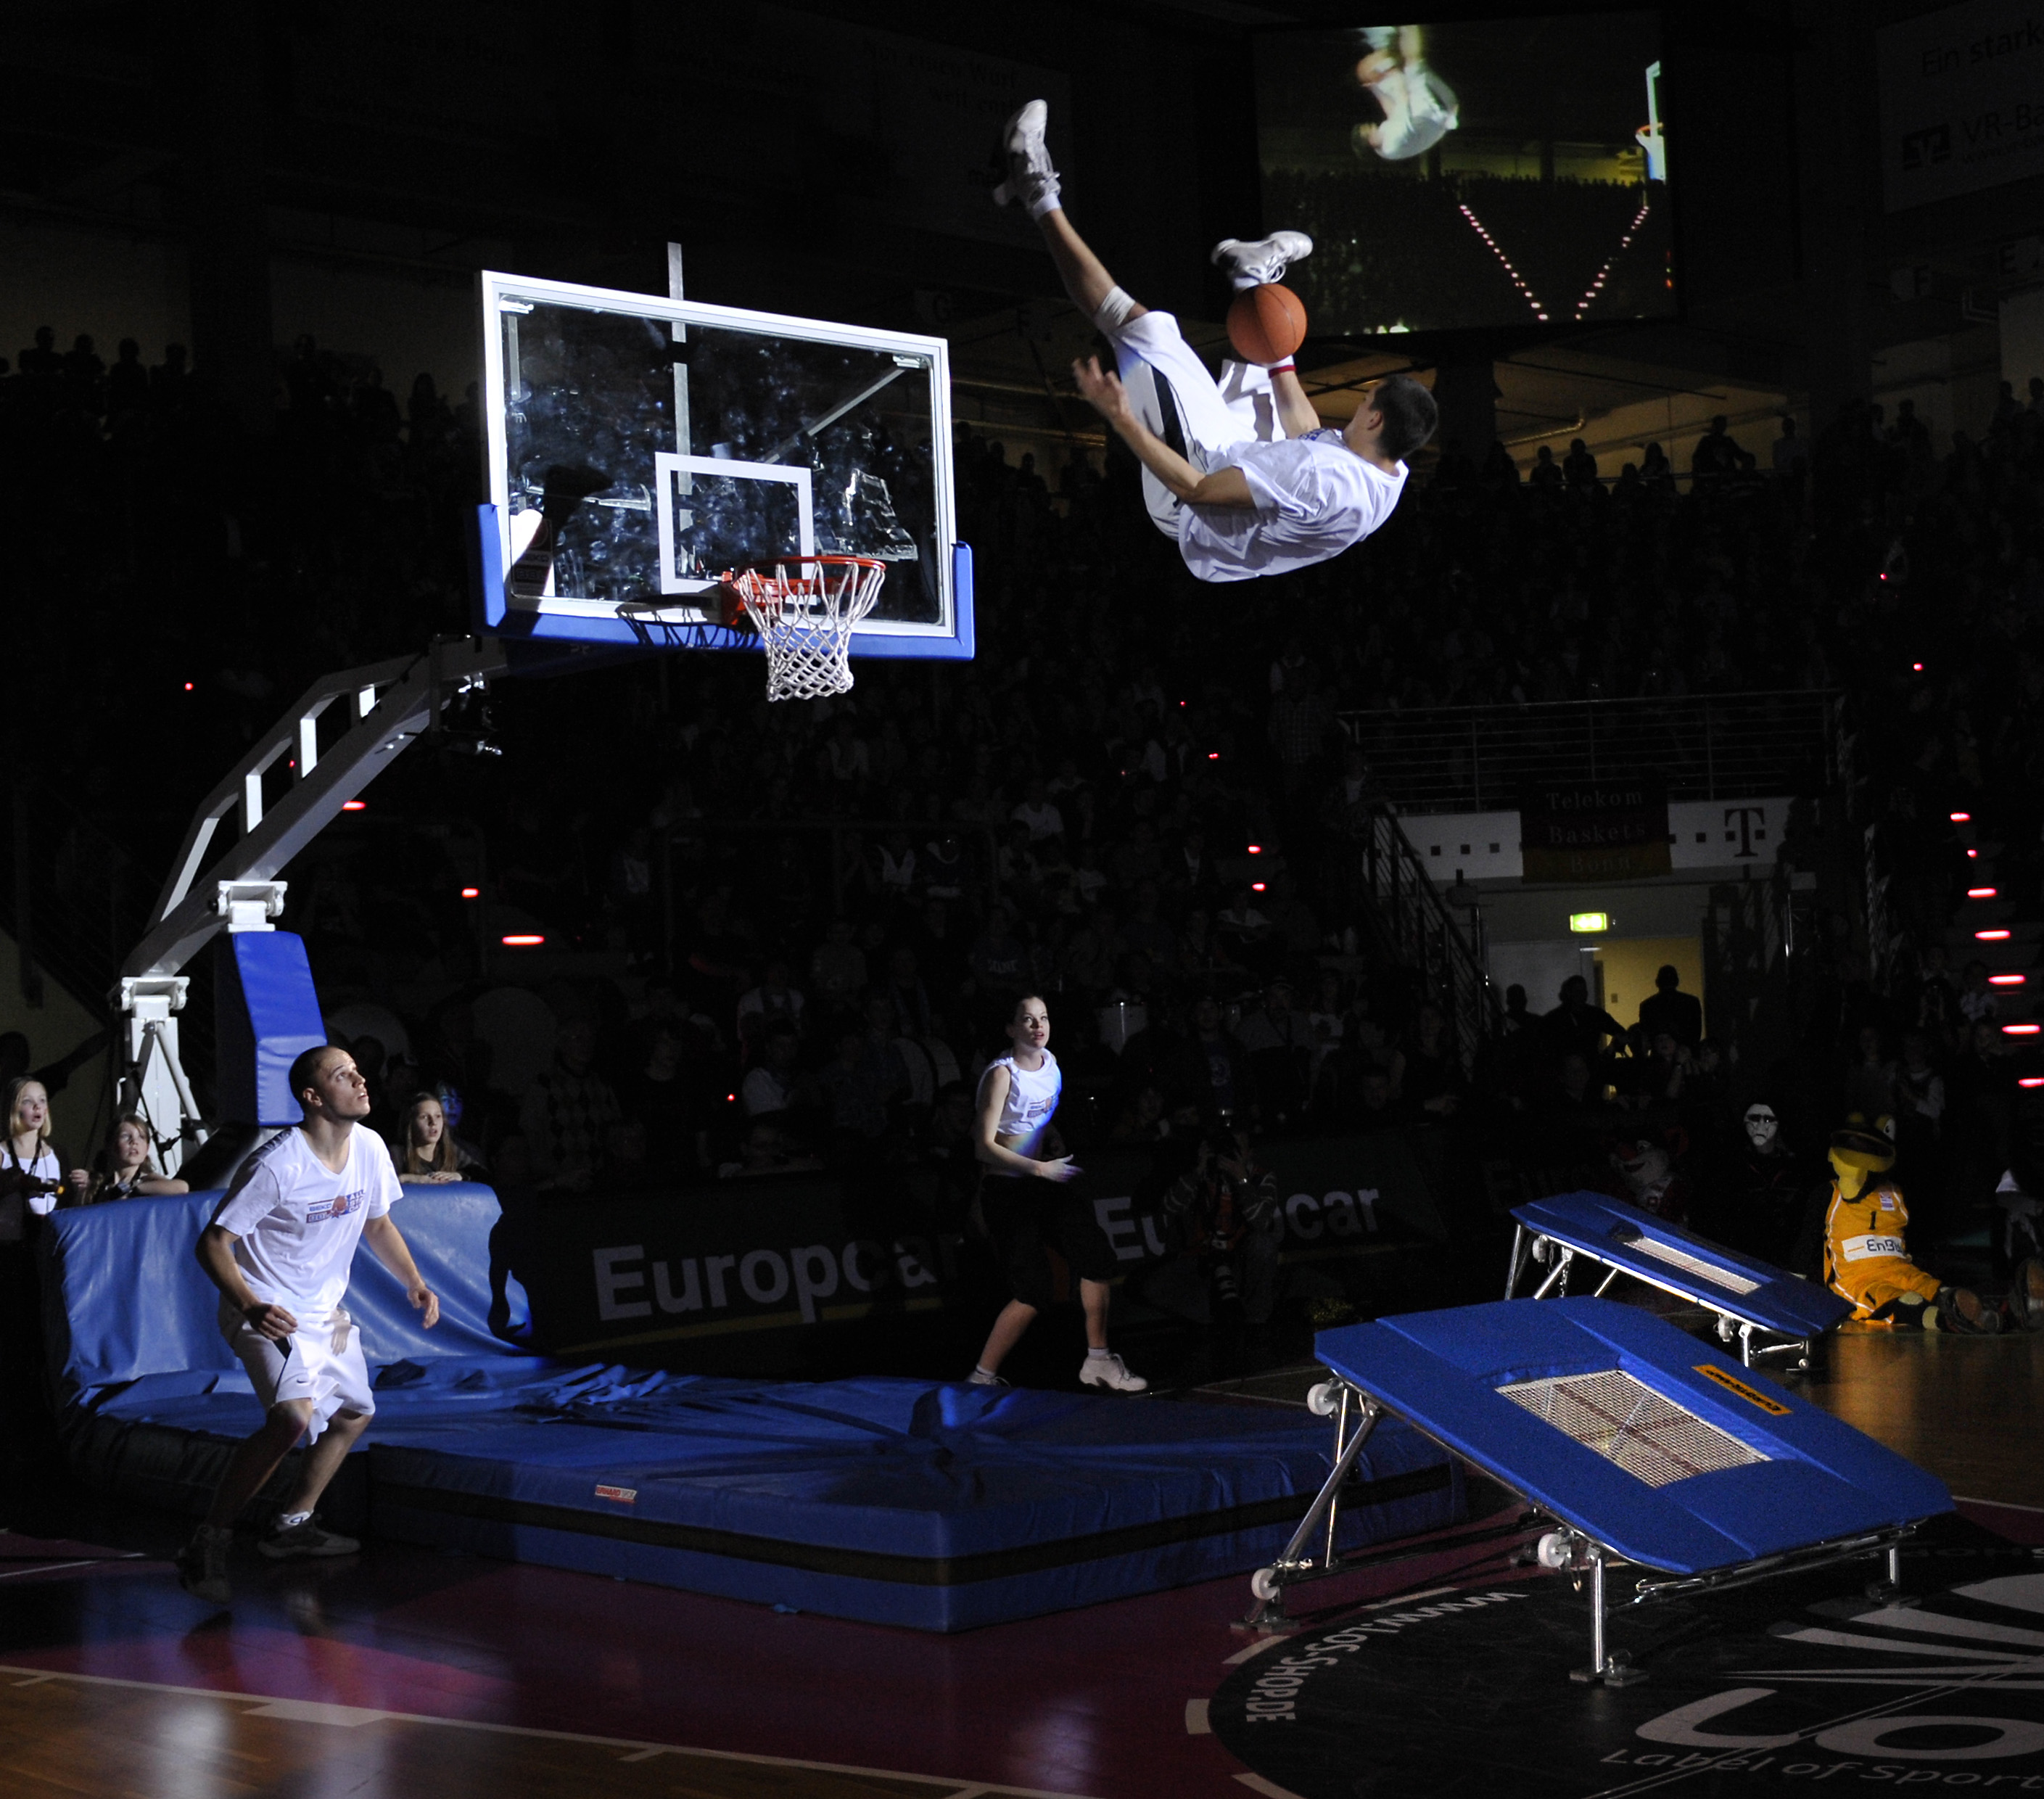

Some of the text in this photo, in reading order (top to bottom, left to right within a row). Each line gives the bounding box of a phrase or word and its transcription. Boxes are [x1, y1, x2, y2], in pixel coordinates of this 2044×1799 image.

[1922, 18, 2044, 77] Ein stark
[1999, 243, 2017, 275] E
[1913, 264, 1929, 295] F
[1546, 789, 1644, 812] Telekom
[1549, 823, 1647, 845] Baskets
[1724, 807, 1765, 857] T
[1569, 853, 1632, 874] Bonn
[1869, 1211, 1877, 1230] 1
[593, 1232, 964, 1325] Europcar
[1599, 1748, 1776, 1773] Label
[1781, 1761, 1864, 1780] of
